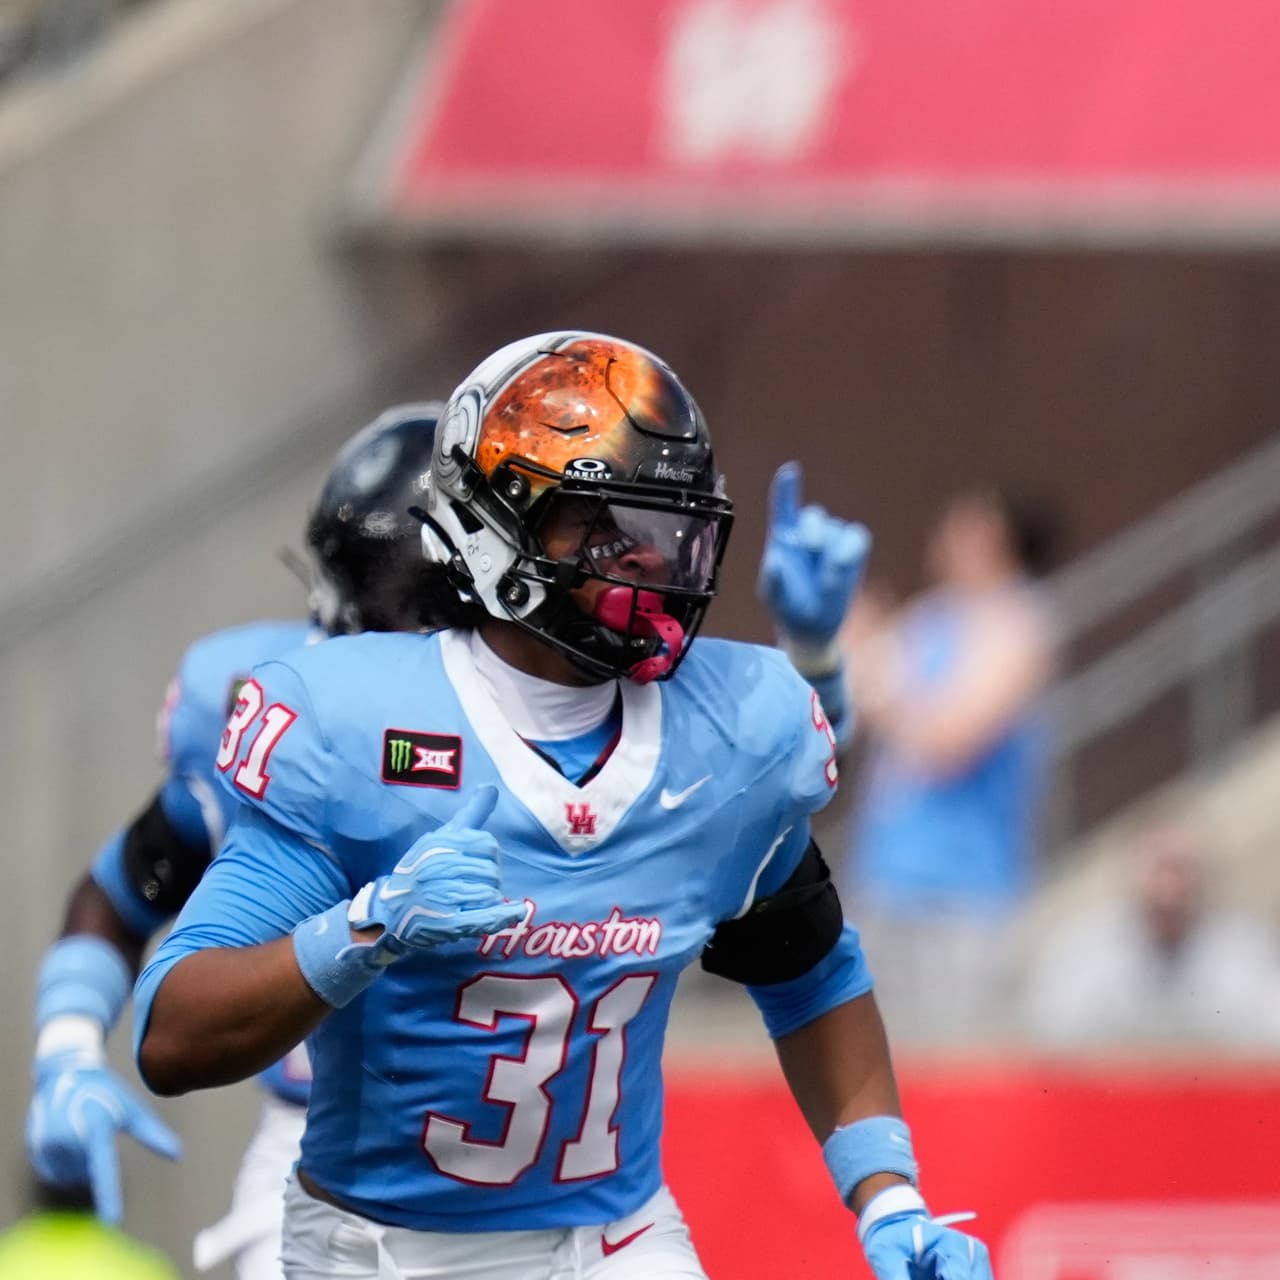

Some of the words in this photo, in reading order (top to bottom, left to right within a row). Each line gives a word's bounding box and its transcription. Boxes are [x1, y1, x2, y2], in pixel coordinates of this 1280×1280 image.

[654, 461, 694, 483] Houston
[215, 677, 299, 800] 31
[564, 802, 597, 836] UH
[477, 898, 662, 959] Houston
[421, 970, 660, 1188] 31
